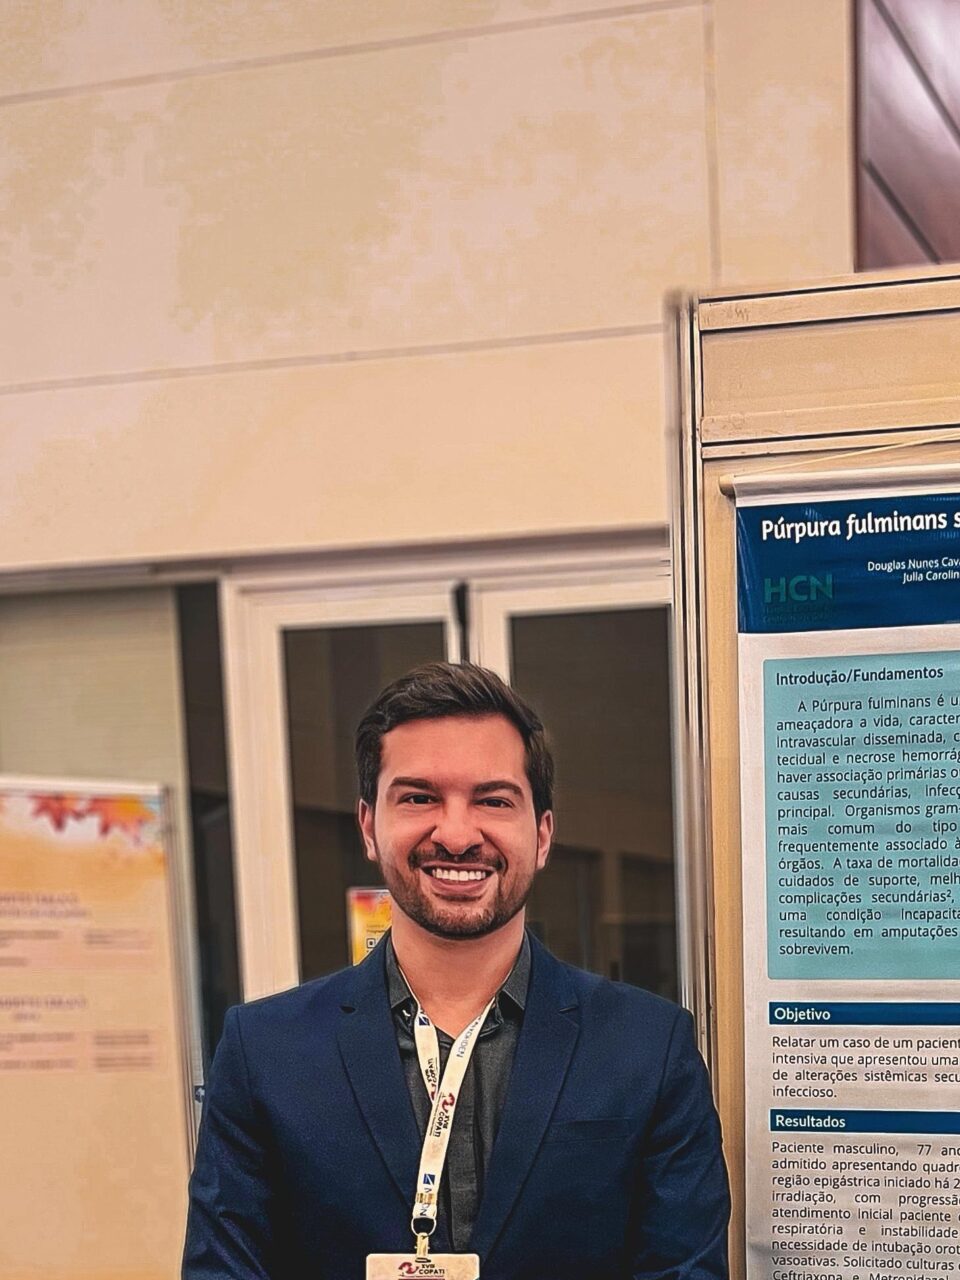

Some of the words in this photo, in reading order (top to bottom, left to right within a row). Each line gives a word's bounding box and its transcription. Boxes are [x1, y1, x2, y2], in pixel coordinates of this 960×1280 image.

[762, 510, 841, 544] Púrpura
[846, 510, 947, 540] fulminans
[868, 560, 906, 572] Douglas
[908, 559, 939, 569] Nunes
[764, 573, 833, 603] HCN
[776, 667, 943, 686] Introdução/Fundamentos
[798, 701, 807, 712] A
[812, 699, 862, 714] Púrpura
[868, 696, 930, 709] fulminans
[937, 694, 944, 706] é
[777, 716, 853, 733] ameaçadora
[860, 718, 866, 728] a
[873, 714, 902, 728] vida,
[778, 805, 834, 821] principal.
[845, 804, 920, 820] Organismos
[774, 1008, 830, 1022] Objetivo
[772, 1036, 816, 1047] Relatar
[820, 1039, 839, 1048] um
[843, 1039, 870, 1048] caso
[874, 1036, 889, 1048] de
[893, 1040, 913, 1048] um
[773, 1085, 837, 1098] infeccioso.
[776, 1115, 846, 1128] Resultados
[772, 1142, 824, 1153] Paciente
[834, 1143, 898, 1156] masculino,
[917, 1144, 932, 1156] 77
